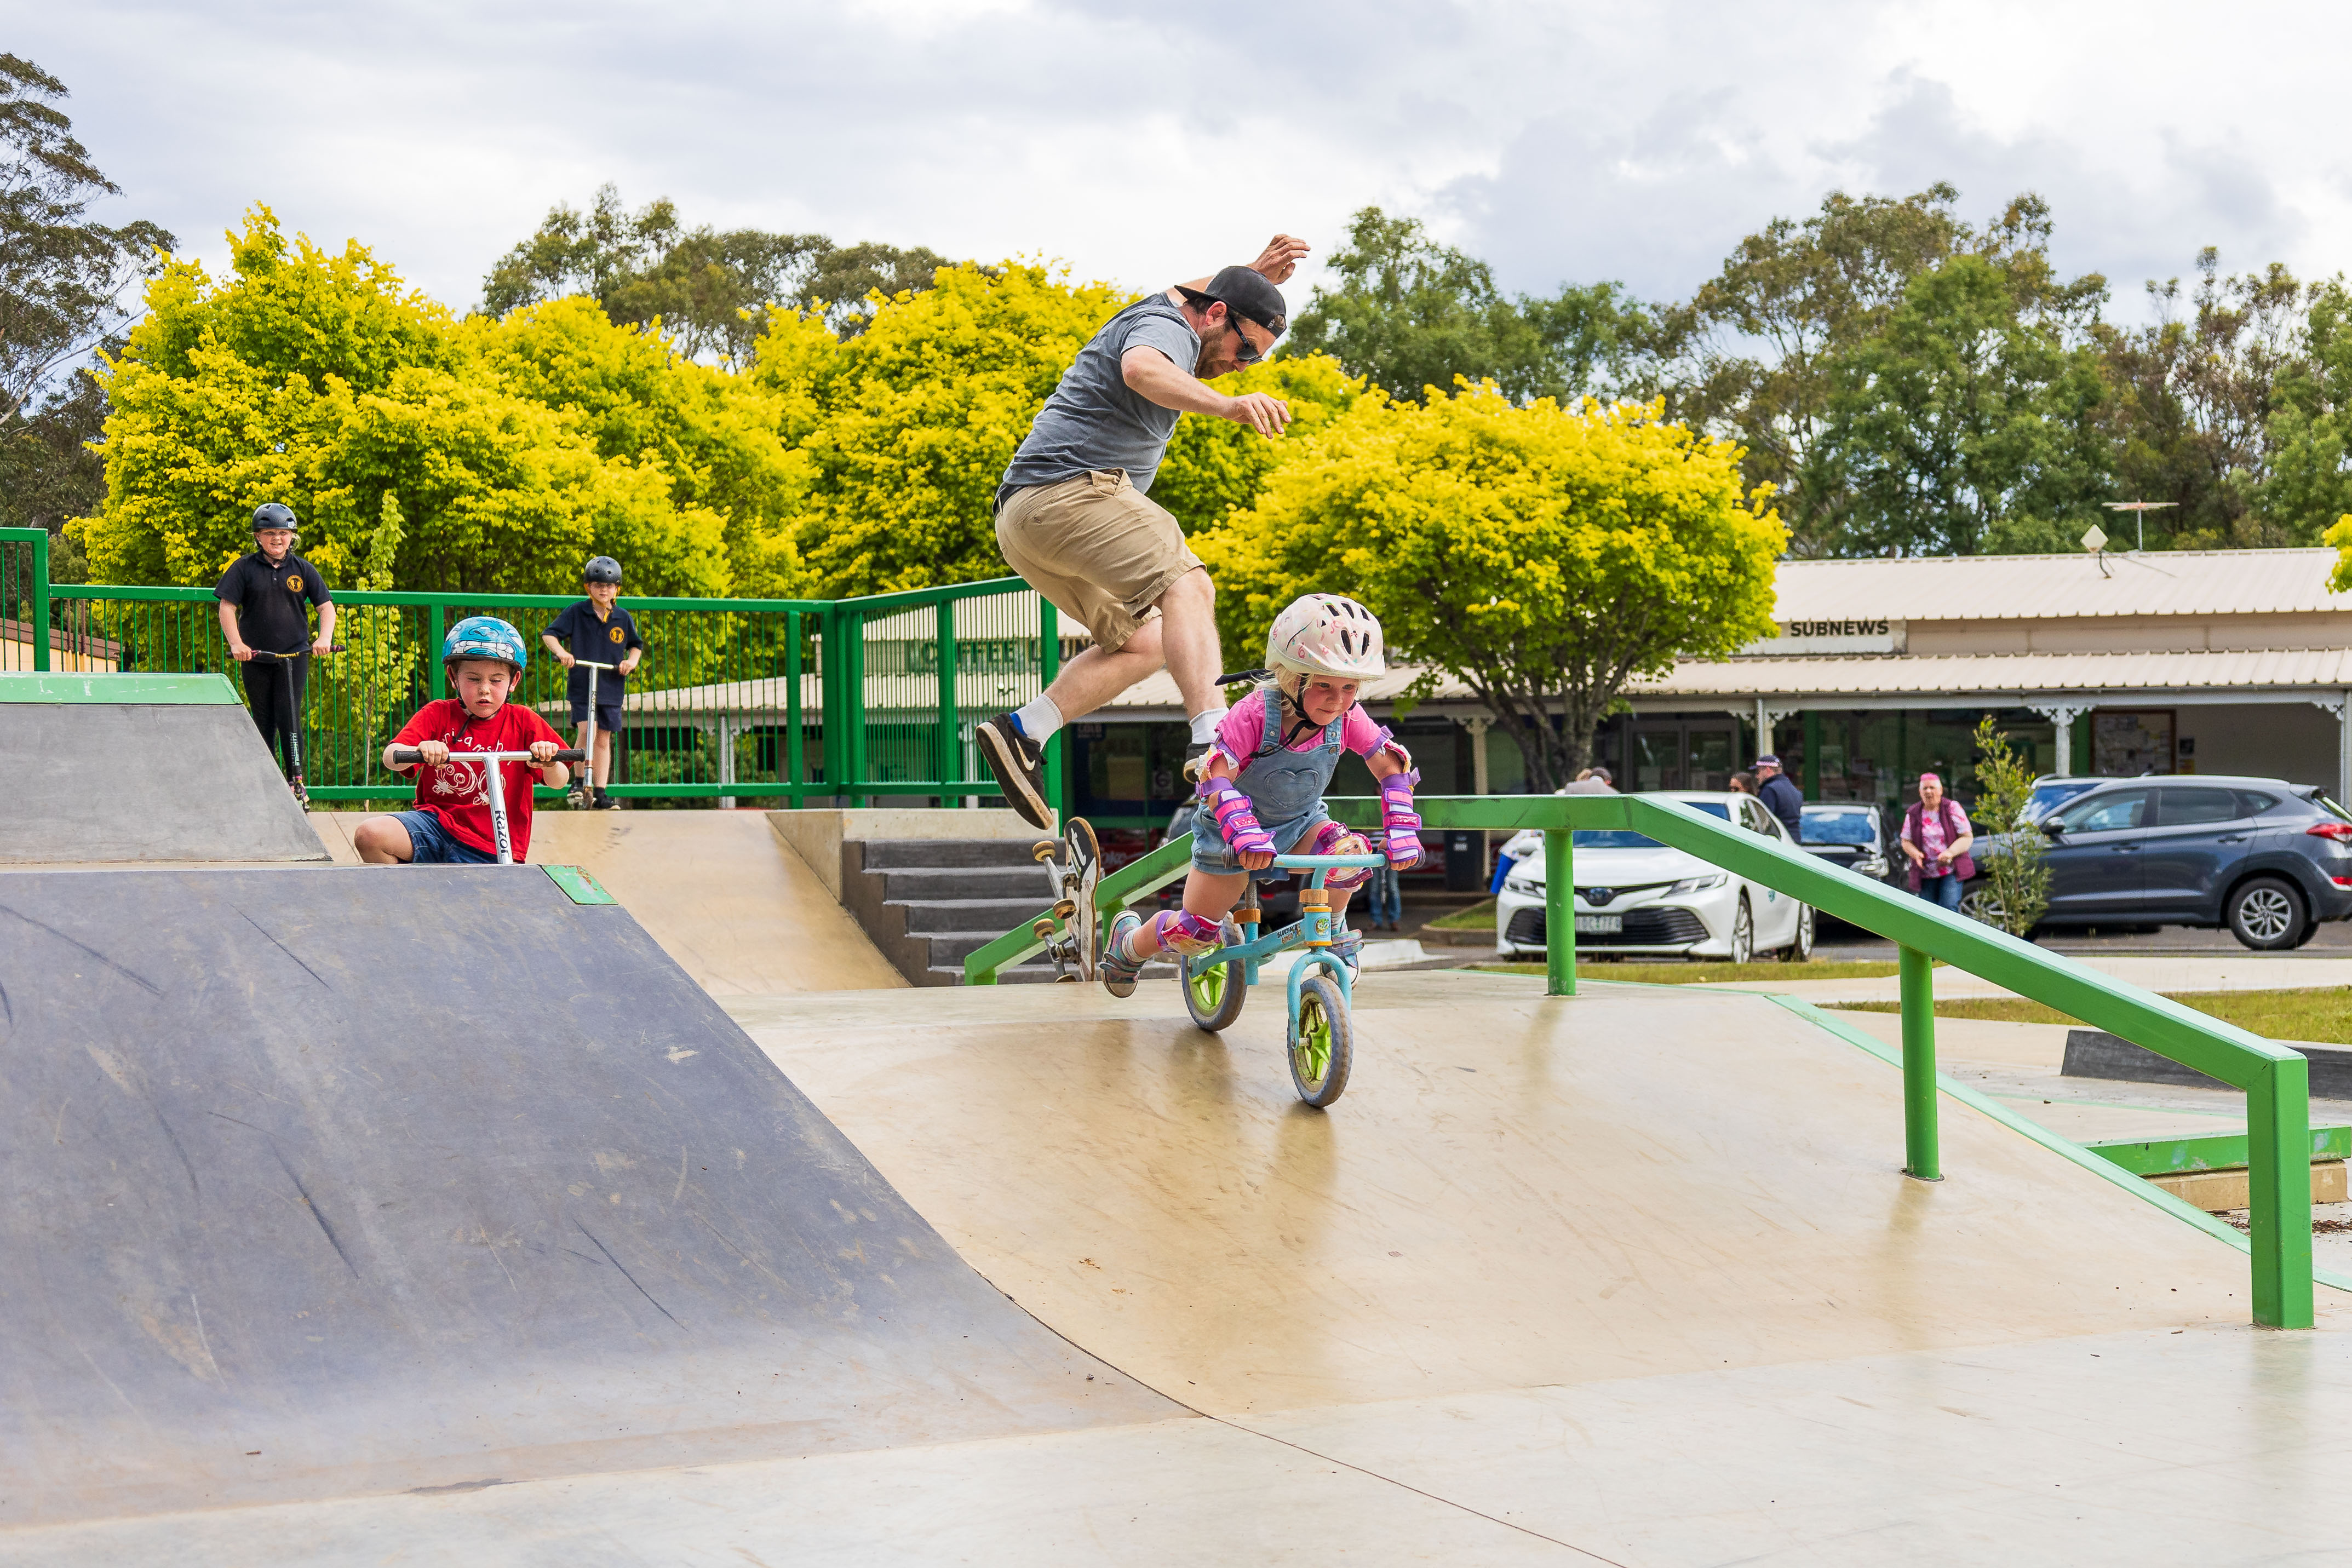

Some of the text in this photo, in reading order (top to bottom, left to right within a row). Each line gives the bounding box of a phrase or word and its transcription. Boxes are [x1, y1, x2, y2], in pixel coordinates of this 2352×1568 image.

[1790, 621, 1889, 637] SUBNEWS
[922, 637, 1096, 663] CFFEE LUN
[495, 810, 510, 858] Razor
